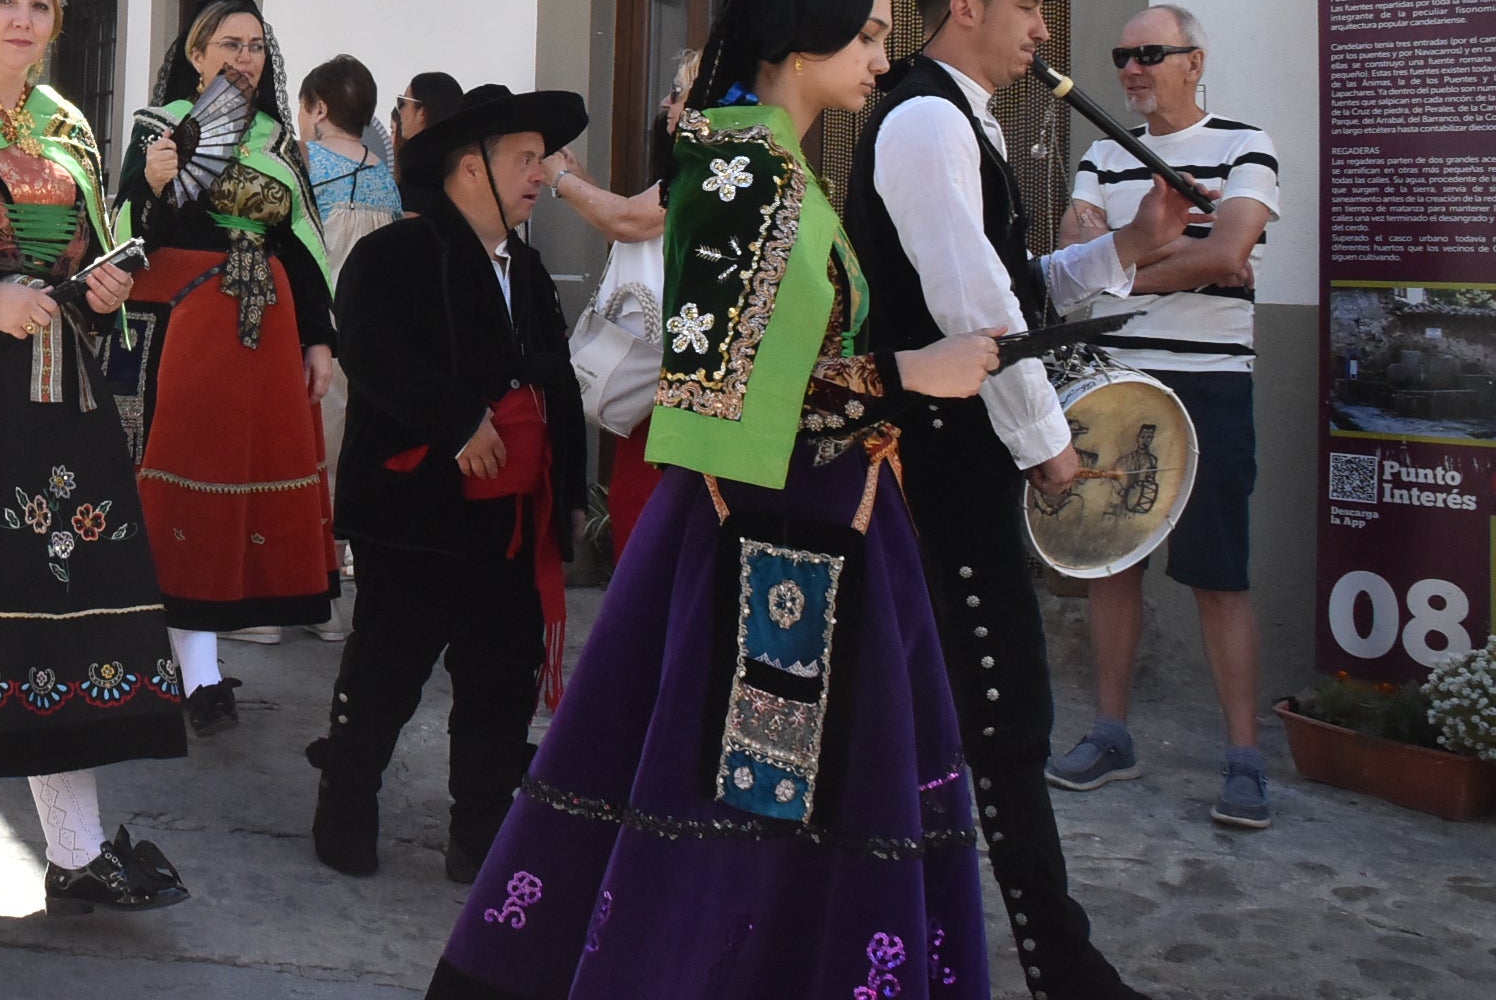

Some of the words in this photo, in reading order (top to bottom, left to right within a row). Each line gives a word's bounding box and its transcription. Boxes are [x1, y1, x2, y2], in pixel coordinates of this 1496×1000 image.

[1330, 4, 1344, 12] Las
[1344, 2, 1374, 11] fuentes
[1375, 0, 1415, 11] repartidas
[1415, 0, 1430, 9] por
[1331, 12, 1374, 23] integrante
[1380, 11, 1392, 19] de
[1398, 10, 1406, 18] la
[1412, 7, 1448, 18] peculiar
[1331, 21, 1377, 32] arquitectura
[1378, 19, 1409, 30] popular
[1396, 40, 1412, 48] tres
[1412, 38, 1448, 47] entradas
[1469, 36, 1478, 44] el
[1331, 54, 1345, 62] por
[1359, 50, 1391, 60] puentes
[1398, 50, 1413, 59] por
[1331, 61, 1349, 69] ellas
[1428, 57, 1455, 65] fuente
[1459, 56, 1492, 64] romana
[1371, 69, 1392, 77] Estas
[1392, 68, 1409, 76] tres
[1409, 67, 1440, 76] fuentes
[1440, 66, 1471, 74] existen
[1331, 80, 1342, 88] de
[1410, 77, 1421, 85] de
[1426, 76, 1439, 84] los
[1443, 75, 1478, 84] Puentes
[1377, 88, 1388, 96] Ya
[1388, 87, 1416, 95] dentro
[1430, 86, 1460, 95] pueblo
[1331, 98, 1360, 107] fuentes
[1360, 99, 1377, 107] que
[1377, 97, 1410, 107] salpican
[1423, 96, 1444, 104] cada
[1475, 94, 1487, 102] de
[1331, 108, 1342, 116] de
[1342, 108, 1350, 116] la
[1351, 107, 1371, 115] Cruz
[1371, 107, 1383, 115] de
[1457, 104, 1469, 112] de
[1470, 104, 1479, 112] la
[1407, 115, 1421, 123] del
[1462, 114, 1474, 122] de
[1342, 127, 1363, 136] largo
[1397, 125, 1419, 133] hasta
[1419, 124, 1467, 132] contabilizar
[1332, 146, 1380, 155] REGADERAS
[1346, 157, 1385, 167] regaderas
[1387, 157, 1414, 166] parten
[1415, 156, 1426, 164] de
[1428, 156, 1444, 164] dos
[1445, 156, 1480, 165] grandes
[1397, 166, 1419, 174] otras
[1443, 165, 1484, 174] pequeñas
[1331, 176, 1353, 184] todas
[1354, 176, 1366, 184] las
[1428, 175, 1477, 184] procedente
[1331, 187, 1347, 195] que
[1351, 187, 1379, 195] surgen
[1332, 195, 1382, 203] saneamiento
[1344, 205, 1373, 214] tiempo
[1449, 204, 1490, 212] mantener
[1332, 214, 1354, 222] calles
[1438, 214, 1488, 223] desangrado
[1332, 234, 1369, 243] Superado
[1375, 234, 1383, 242] el
[1419, 234, 1449, 242] urbano
[1332, 243, 1370, 251] diferentes
[1407, 245, 1424, 253] que
[1442, 244, 1475, 252] vecinos
[1477, 244, 1490, 252] de
[1332, 253, 1358, 262] siguen
[1382, 460, 1462, 486] Punto
[1382, 483, 1478, 511] Interés
[1330, 506, 1380, 520] Descarga
[1330, 515, 1341, 525] la
[1343, 516, 1366, 528] App
[1328, 570, 1472, 668] 08
